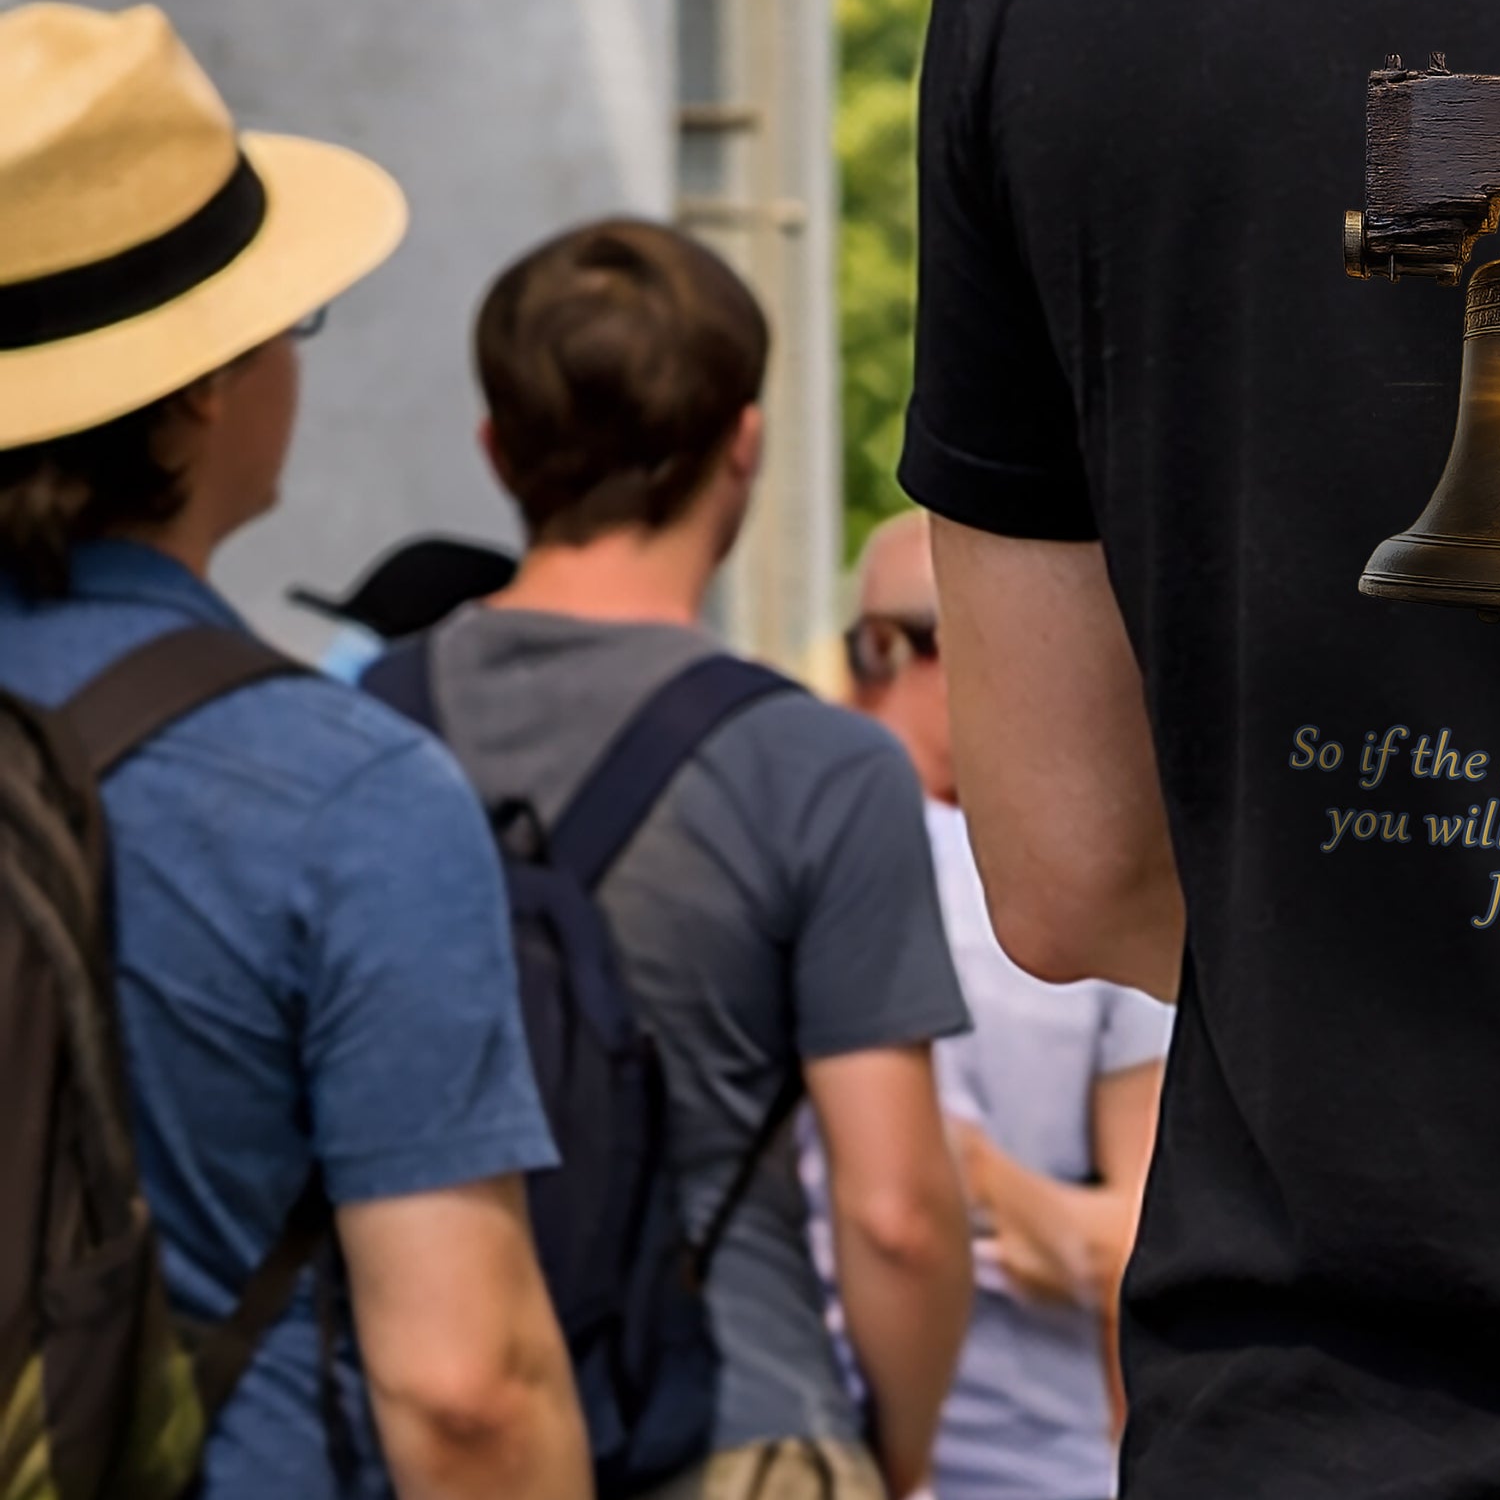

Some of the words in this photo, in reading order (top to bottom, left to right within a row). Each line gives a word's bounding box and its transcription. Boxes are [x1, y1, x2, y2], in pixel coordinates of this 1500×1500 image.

[1289, 726, 1344, 771] So
[1360, 725, 1410, 789] if
[1411, 728, 1488, 781] the
[1321, 806, 1411, 852] you
